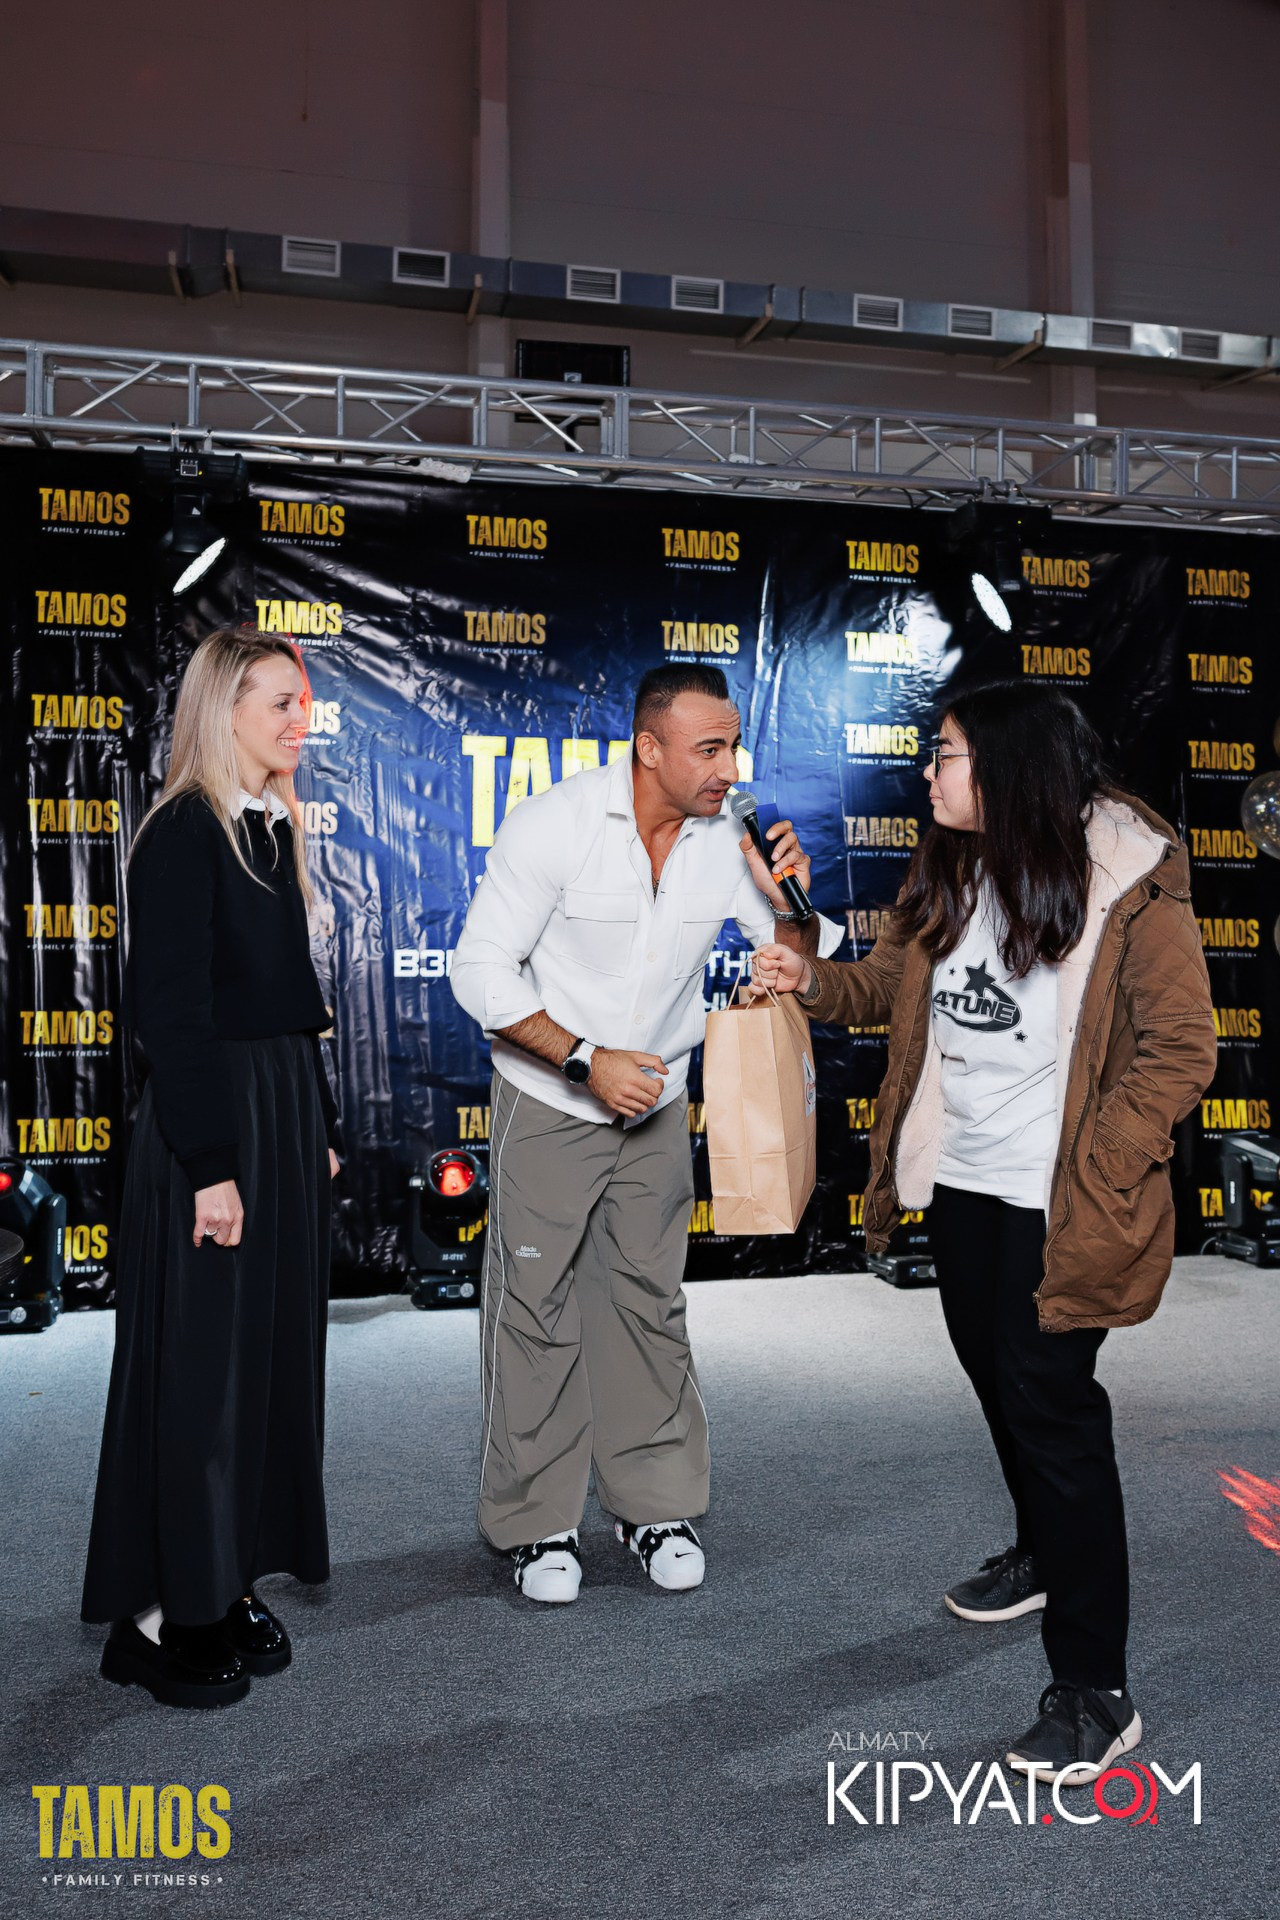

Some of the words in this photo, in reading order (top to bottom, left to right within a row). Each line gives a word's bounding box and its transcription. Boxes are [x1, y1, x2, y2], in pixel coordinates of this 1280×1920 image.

[39, 488, 130, 525] TAMOS
[259, 500, 345, 537] TAMOS
[466, 515, 548, 550] TAMOS
[661, 528, 740, 562] TAMOS
[846, 540, 919, 574] TAMOS
[1021, 556, 1090, 589] TAMOS
[1186, 568, 1250, 599] TAMOS
[35, 590, 127, 627] TAMOS
[255, 599, 343, 635] TAMOS
[464, 610, 546, 645] TAMOS
[661, 620, 740, 655] TAMOS
[845, 631, 918, 666] TAMOS
[1021, 644, 1091, 676] TAMOS
[1188, 653, 1253, 685] TAMOS
[31, 694, 123, 730] TAMOS
[844, 723, 919, 756] TAMOS
[1188, 740, 1255, 771] TAMOS
[27, 798, 119, 833] TAMOS
[844, 816, 919, 848] TAMOS
[1190, 828, 1258, 859] TAMOS
[24, 904, 116, 938] TAMOS
[933, 990, 1016, 1024] 4TUNE
[20, 1010, 114, 1045] TAMOS
[1200, 1099, 1271, 1129] TAMOS
[16, 1117, 111, 1153] TAMOS
